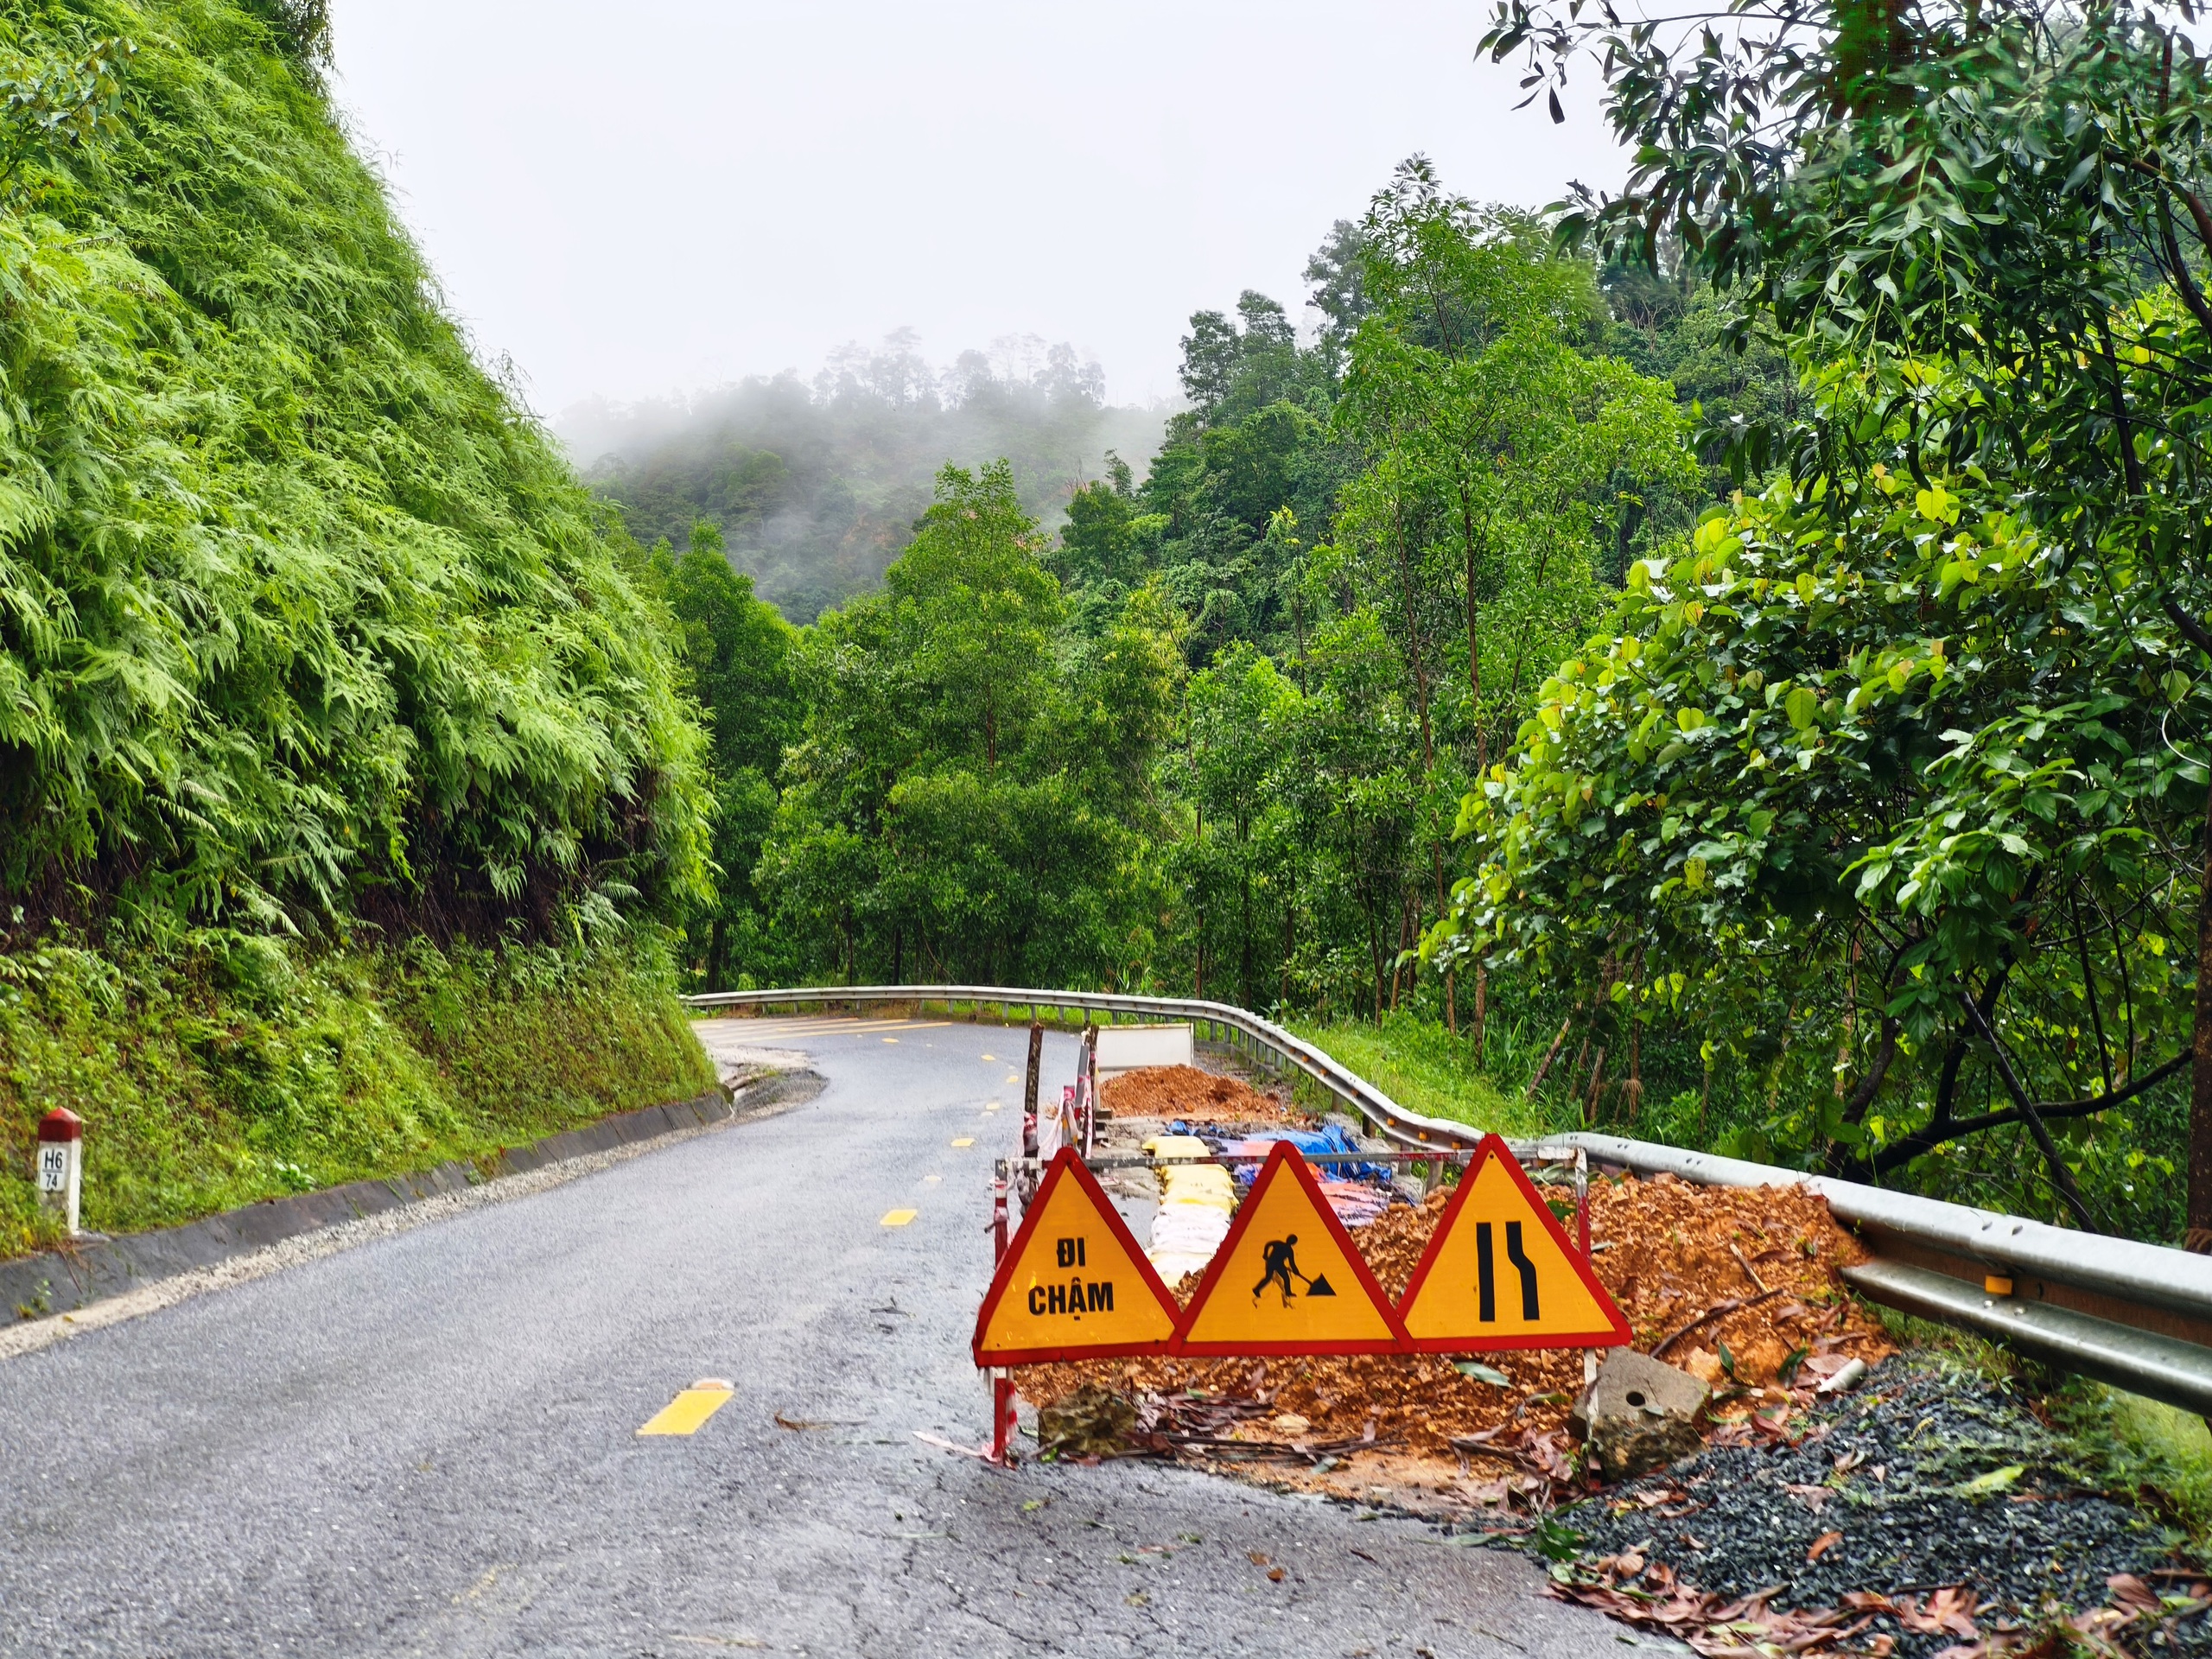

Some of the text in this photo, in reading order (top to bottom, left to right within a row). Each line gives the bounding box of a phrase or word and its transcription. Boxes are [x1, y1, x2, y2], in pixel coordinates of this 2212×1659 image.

[44, 1149, 63, 1169] H6
[46, 1173, 58, 1188] 74
[1057, 1237, 1086, 1268] ĐI
[1028, 1276, 1114, 1321] CHẬM
